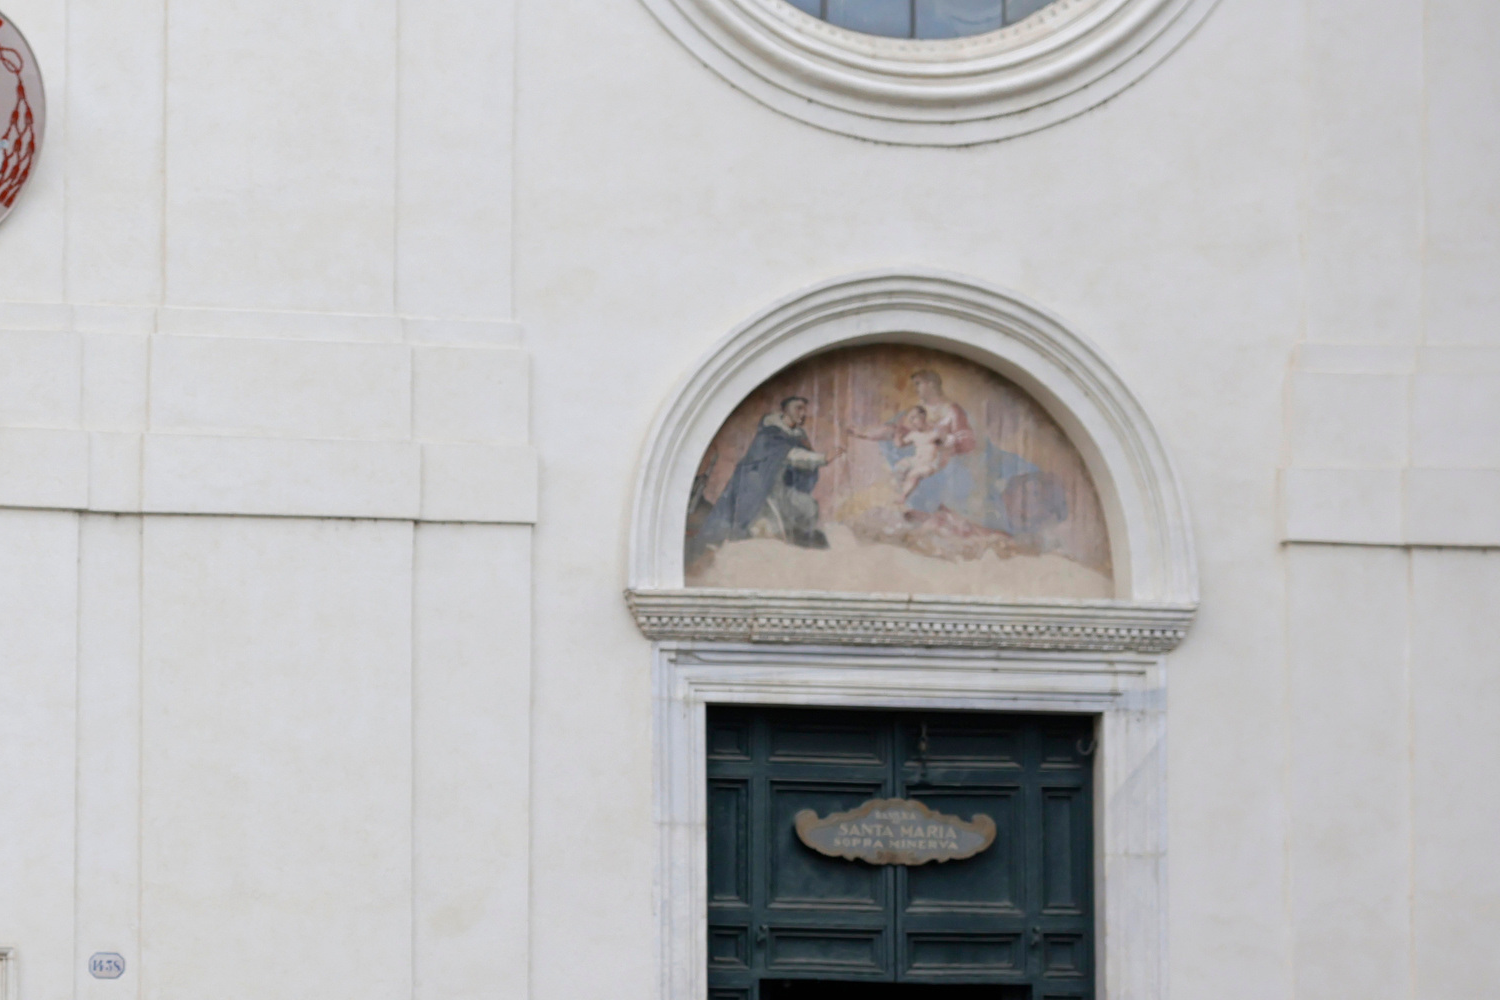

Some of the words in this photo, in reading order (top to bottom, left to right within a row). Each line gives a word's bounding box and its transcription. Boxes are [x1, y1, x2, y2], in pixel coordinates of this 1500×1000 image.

[838, 822, 895, 838] SANTA
[900, 824, 958, 839] MARIA
[833, 837, 884, 848] SOPRA
[889, 838, 959, 850] MINERVA
